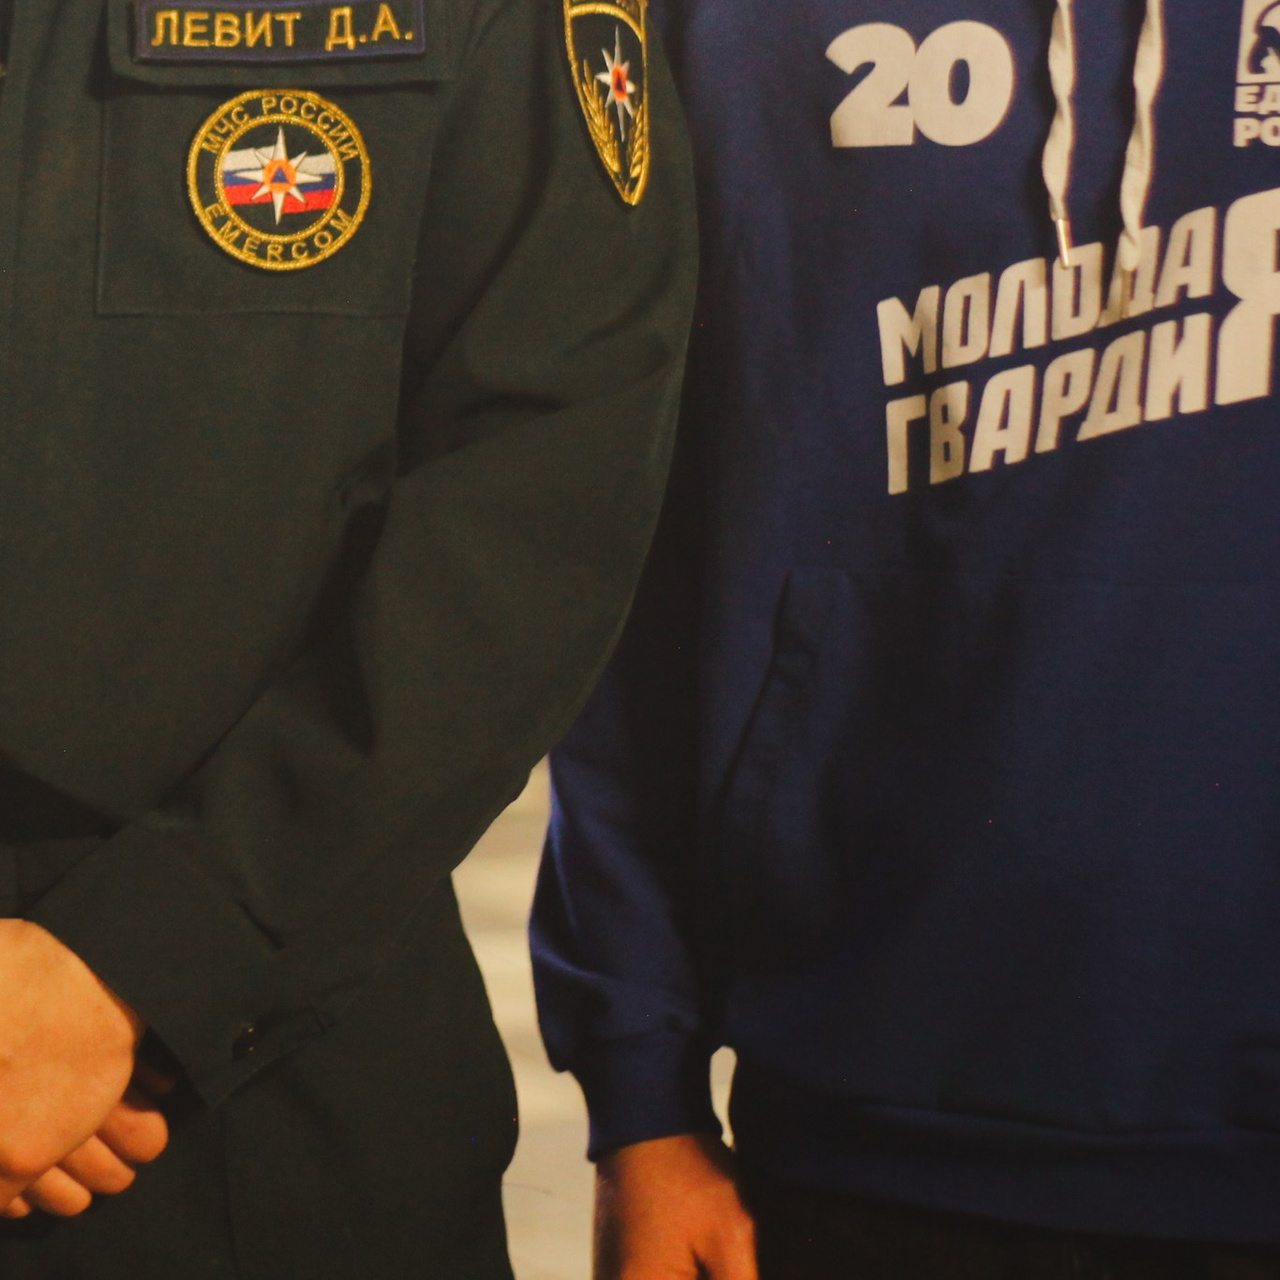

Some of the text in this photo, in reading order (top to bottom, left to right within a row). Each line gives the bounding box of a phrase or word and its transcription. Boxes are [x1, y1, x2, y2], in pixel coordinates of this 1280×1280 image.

[150, 2, 414, 52] ЛЕВИТ Д.А.
[825, 19, 1016, 148] 20
[200, 96, 360, 162] МЧС РОССИИ
[204, 203, 355, 263] EMERCOM
